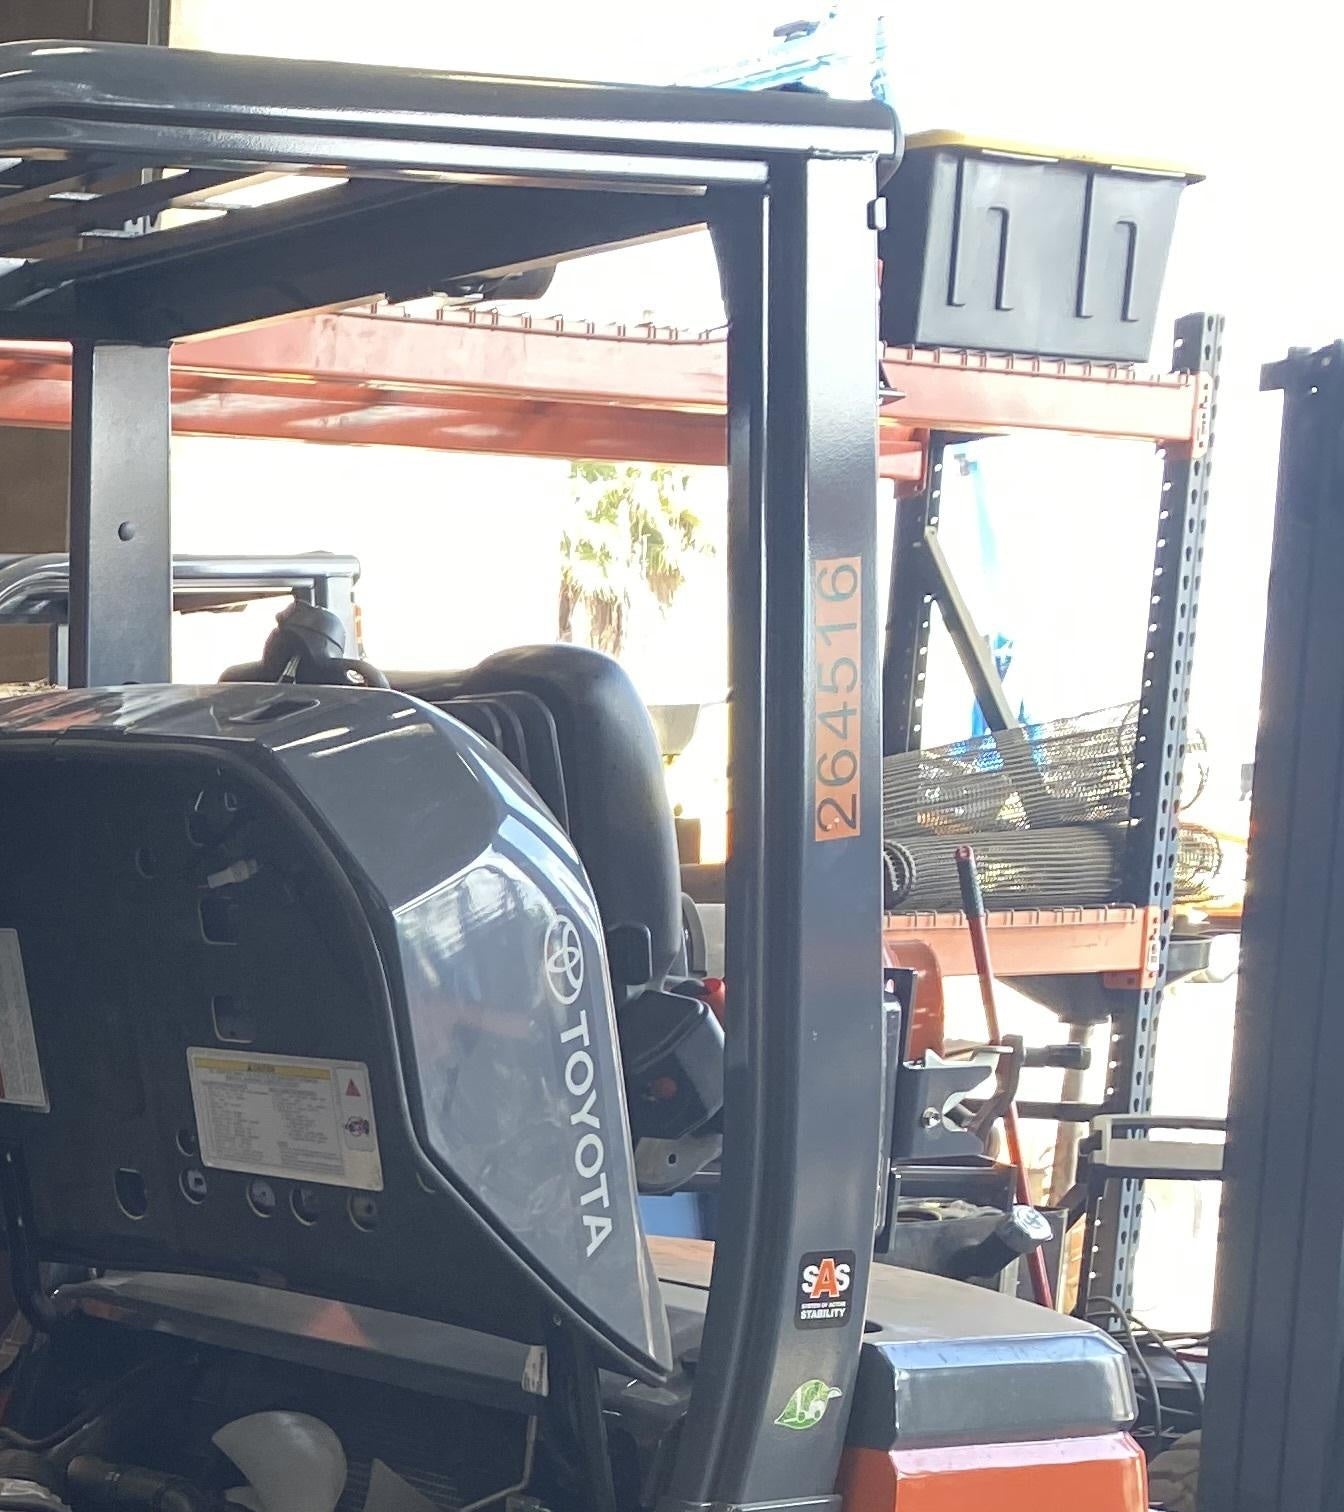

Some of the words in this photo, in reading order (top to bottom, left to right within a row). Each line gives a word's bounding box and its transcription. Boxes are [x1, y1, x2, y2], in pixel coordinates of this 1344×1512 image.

[816, 564, 858, 831] 264516
[559, 1009, 613, 1258] TOYOTA
[800, 1308, 847, 1319] STABILITY
[801, 1258, 851, 1298] SAS
